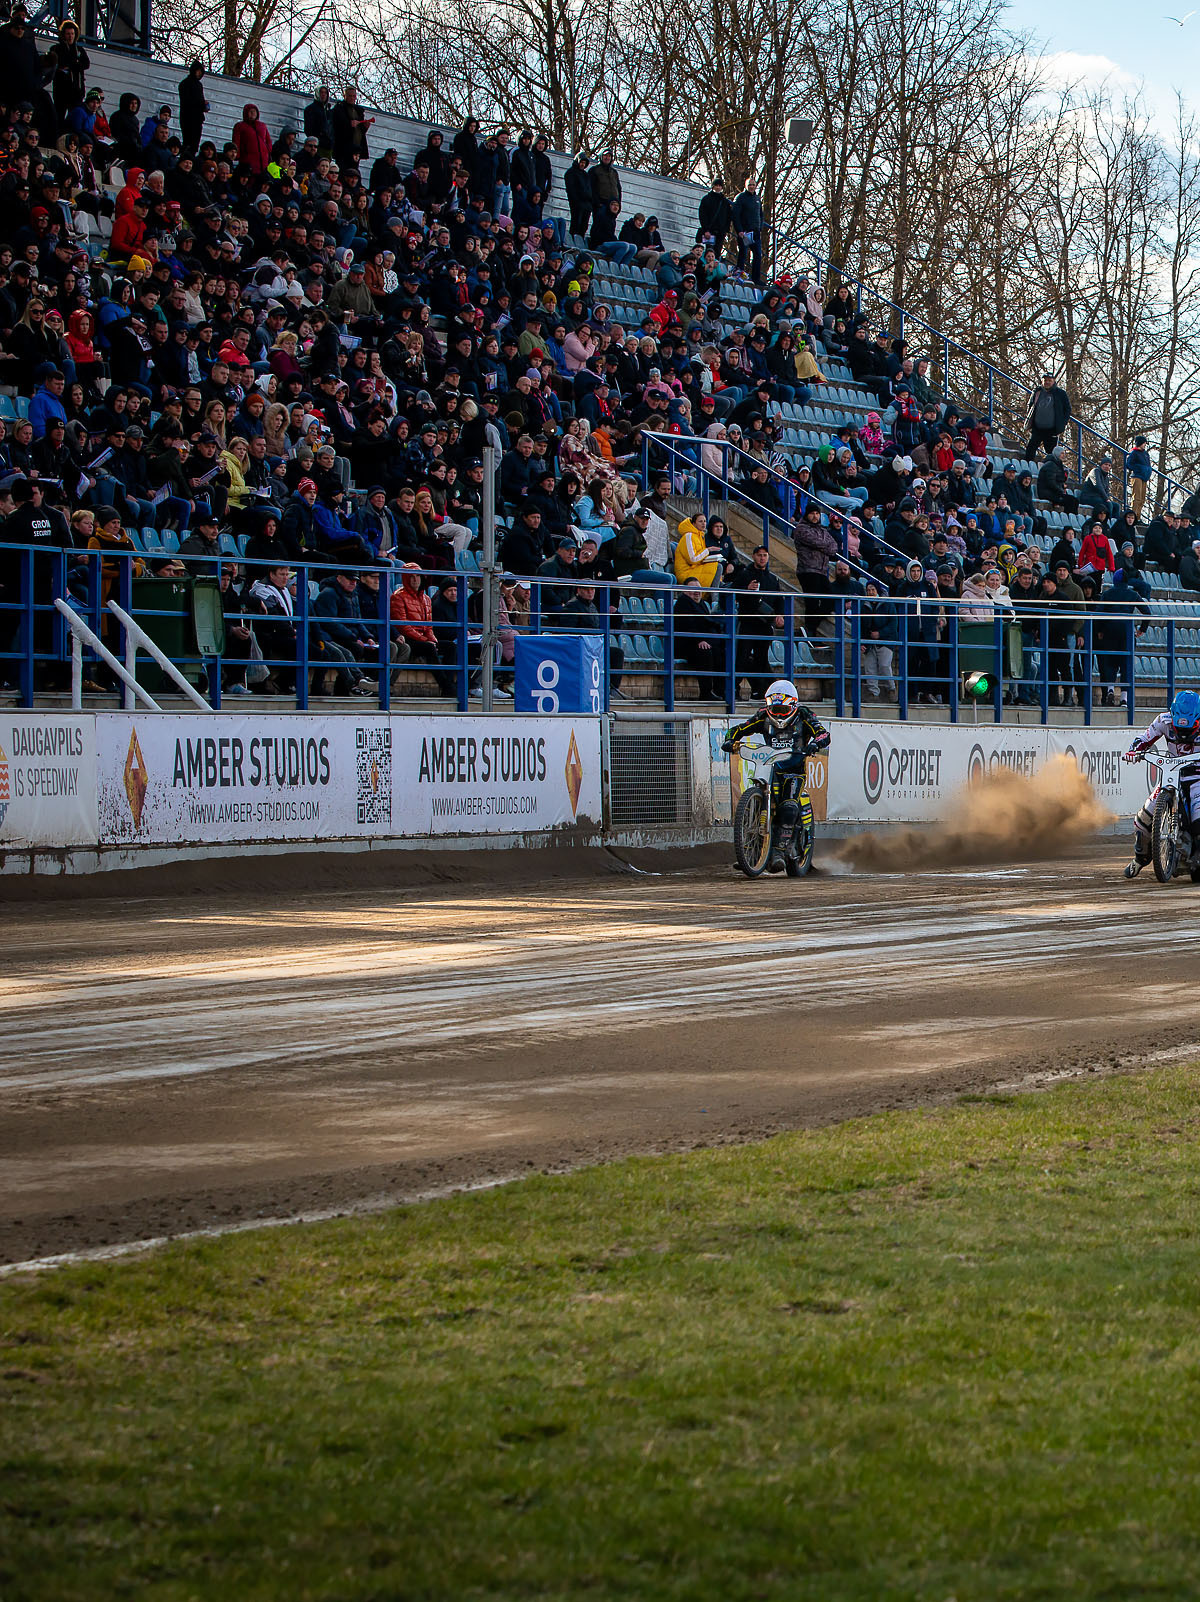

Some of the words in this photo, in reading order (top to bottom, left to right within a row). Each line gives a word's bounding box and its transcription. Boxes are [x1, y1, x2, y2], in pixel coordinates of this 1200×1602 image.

[12, 728, 83, 756] DAUGAVPILS
[172, 737, 245, 788] AMBER
[249, 737, 331, 787] STUDIOS
[418, 737, 477, 783] AMBER
[481, 737, 547, 782] STUDIOS
[888, 747, 942, 786] OPTIBET
[1080, 750, 1122, 785] OPTIBET
[14, 768, 25, 797] IS
[27, 767, 79, 796] SPEEDWAY
[805, 761, 825, 789] RO
[431, 796, 538, 816] WWW.AMBER-STUDIOS.COM
[887, 790, 918, 799] SPORTA
[189, 801, 320, 824] WWW.AMBER-STUDIOS.COM
